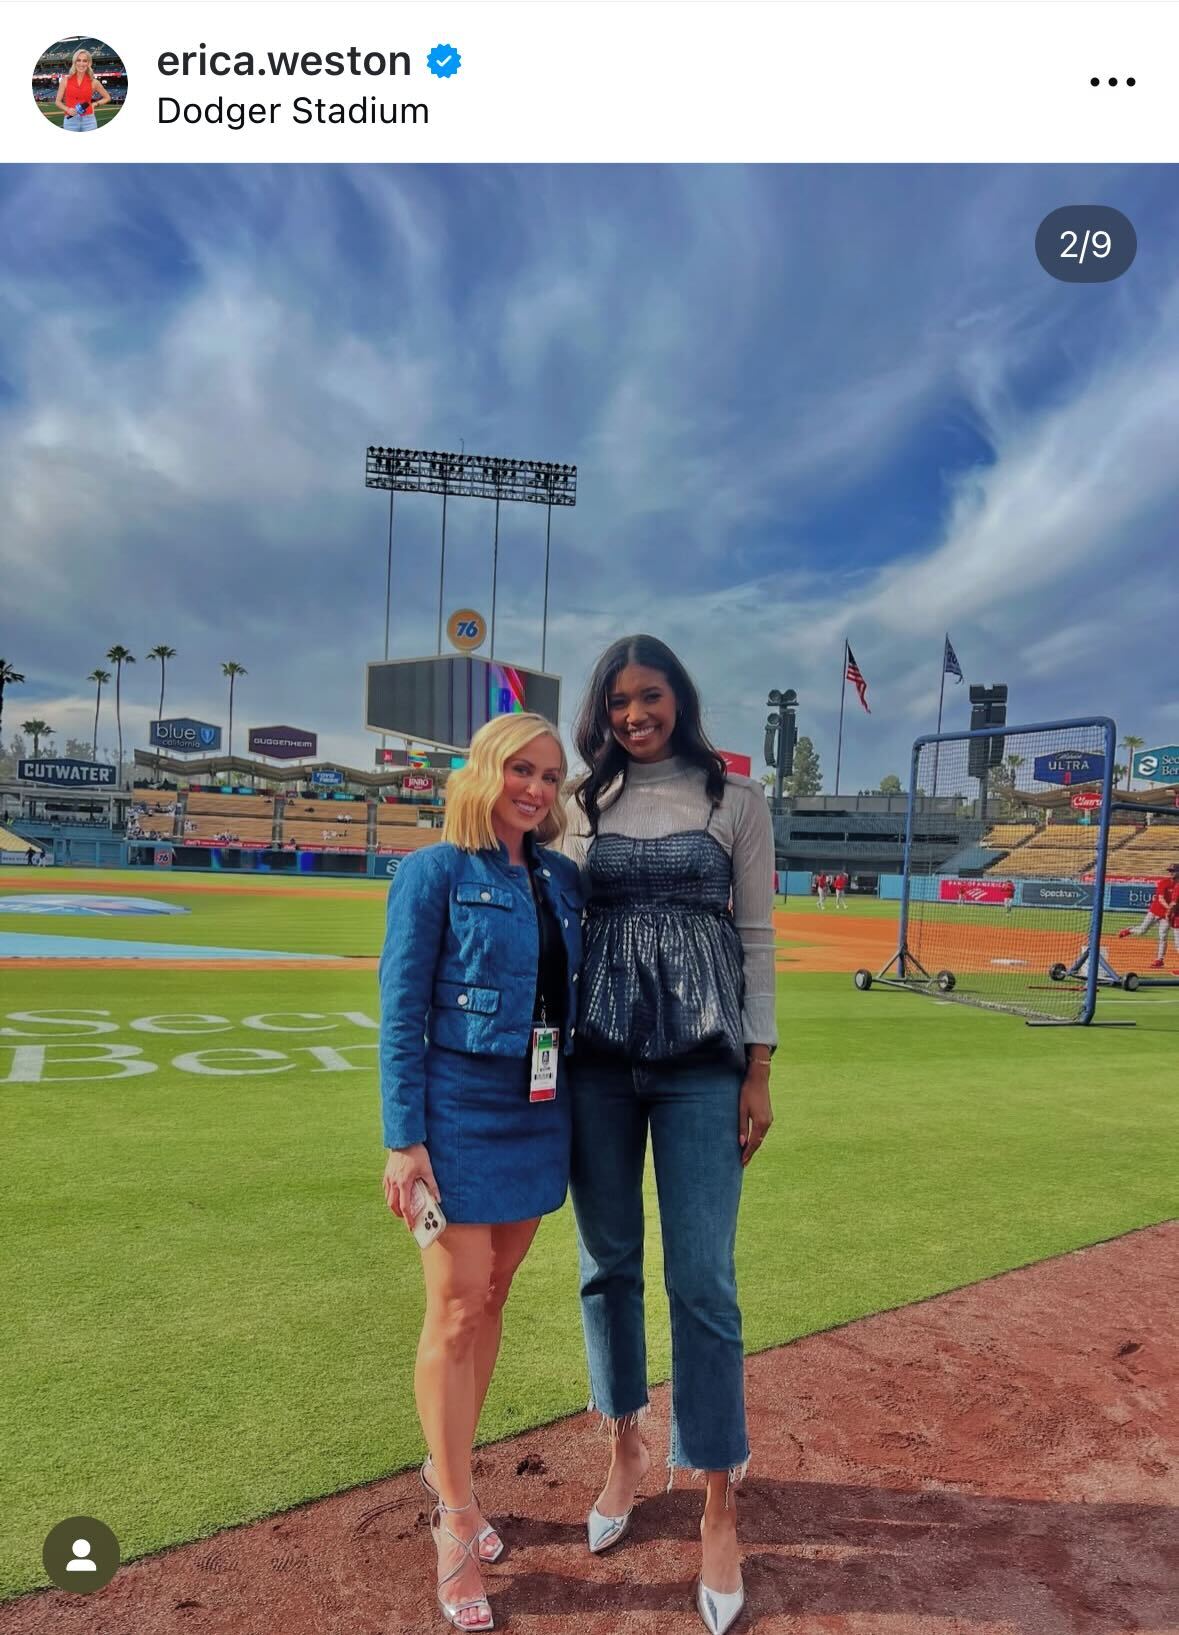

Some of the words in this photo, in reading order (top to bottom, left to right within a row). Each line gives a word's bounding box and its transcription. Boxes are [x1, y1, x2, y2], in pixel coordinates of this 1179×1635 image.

[456, 620, 479, 638] 76
[156, 723, 196, 740] blue
[24, 763, 110, 782] CUTWATER
[1048, 760, 1090, 770] ULTRA
